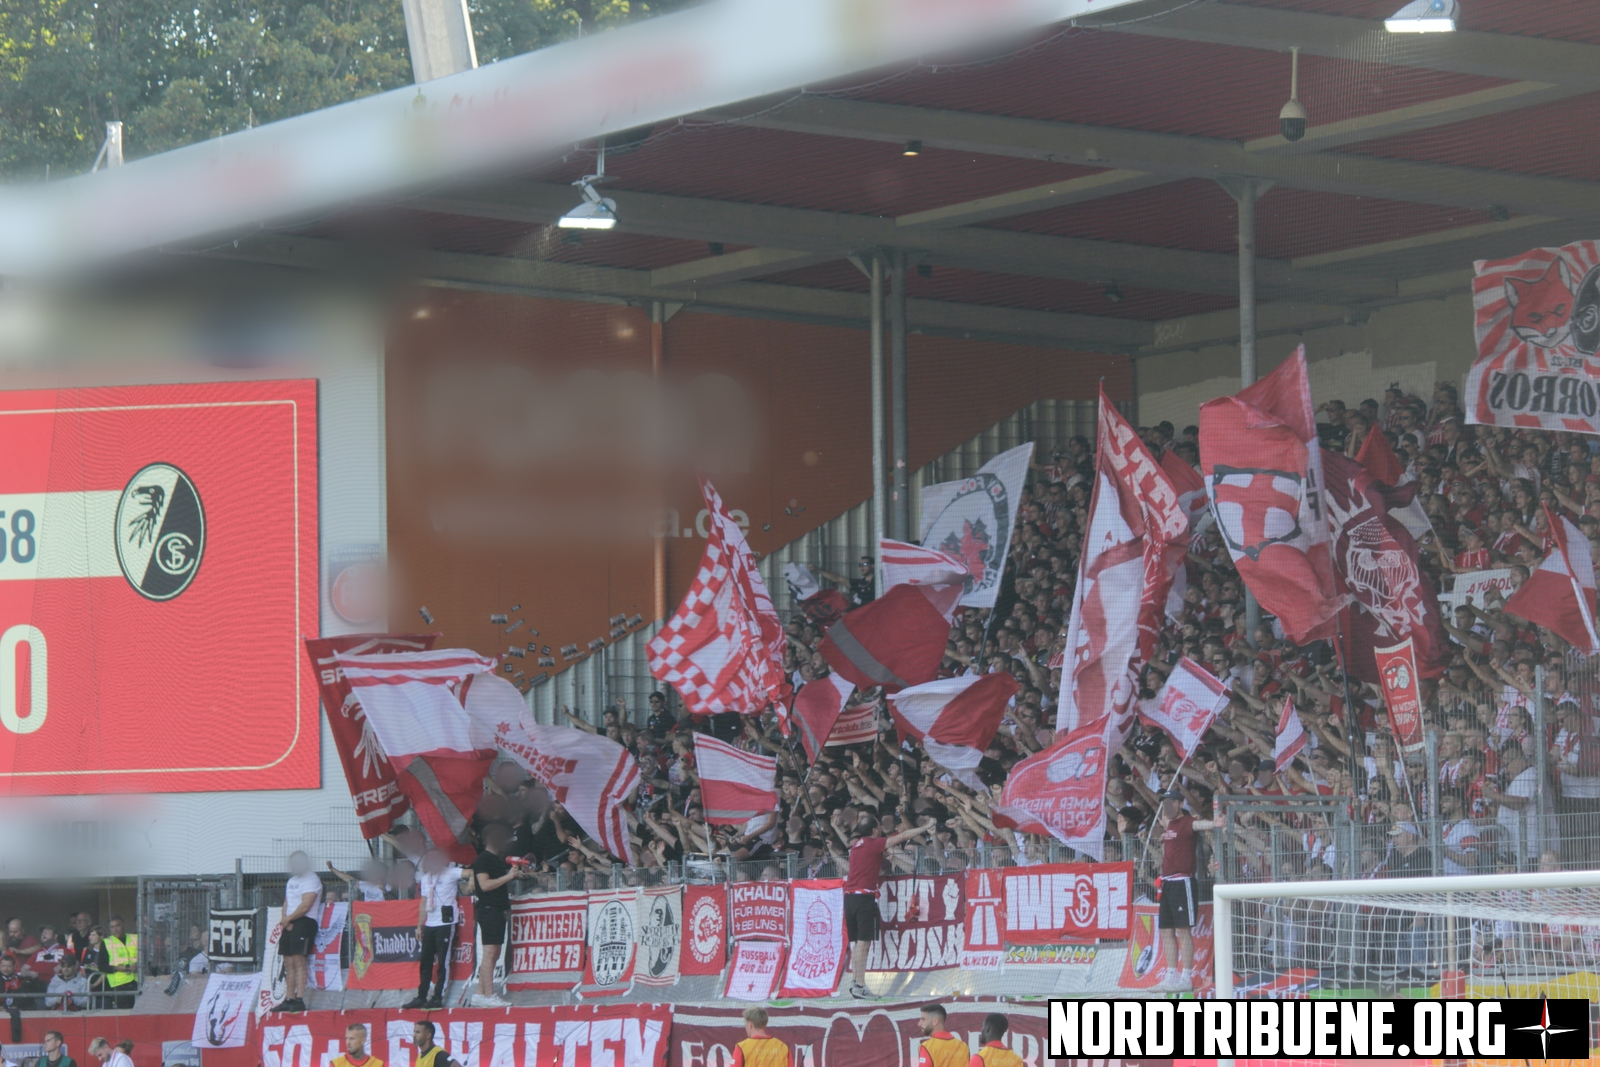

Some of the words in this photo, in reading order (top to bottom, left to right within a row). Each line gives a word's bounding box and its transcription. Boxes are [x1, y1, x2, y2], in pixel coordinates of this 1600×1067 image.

[353, 780, 400, 810] FREIB
[733, 885, 785, 903] KHALID
[734, 904, 753, 918] FÜR
[755, 905, 785, 918] IMMER
[755, 919, 778, 931] UNS
[511, 911, 584, 942] SYNTHESIA
[374, 930, 422, 958] Knaddly
[513, 945, 561, 972] ULTRAS
[564, 944, 581, 970] 79
[740, 949, 777, 963] FUSSBALL
[849, 922, 966, 970] ASCISM
[791, 957, 836, 979] ULTRAS
[386, 1016, 664, 1067] EHALTEN
